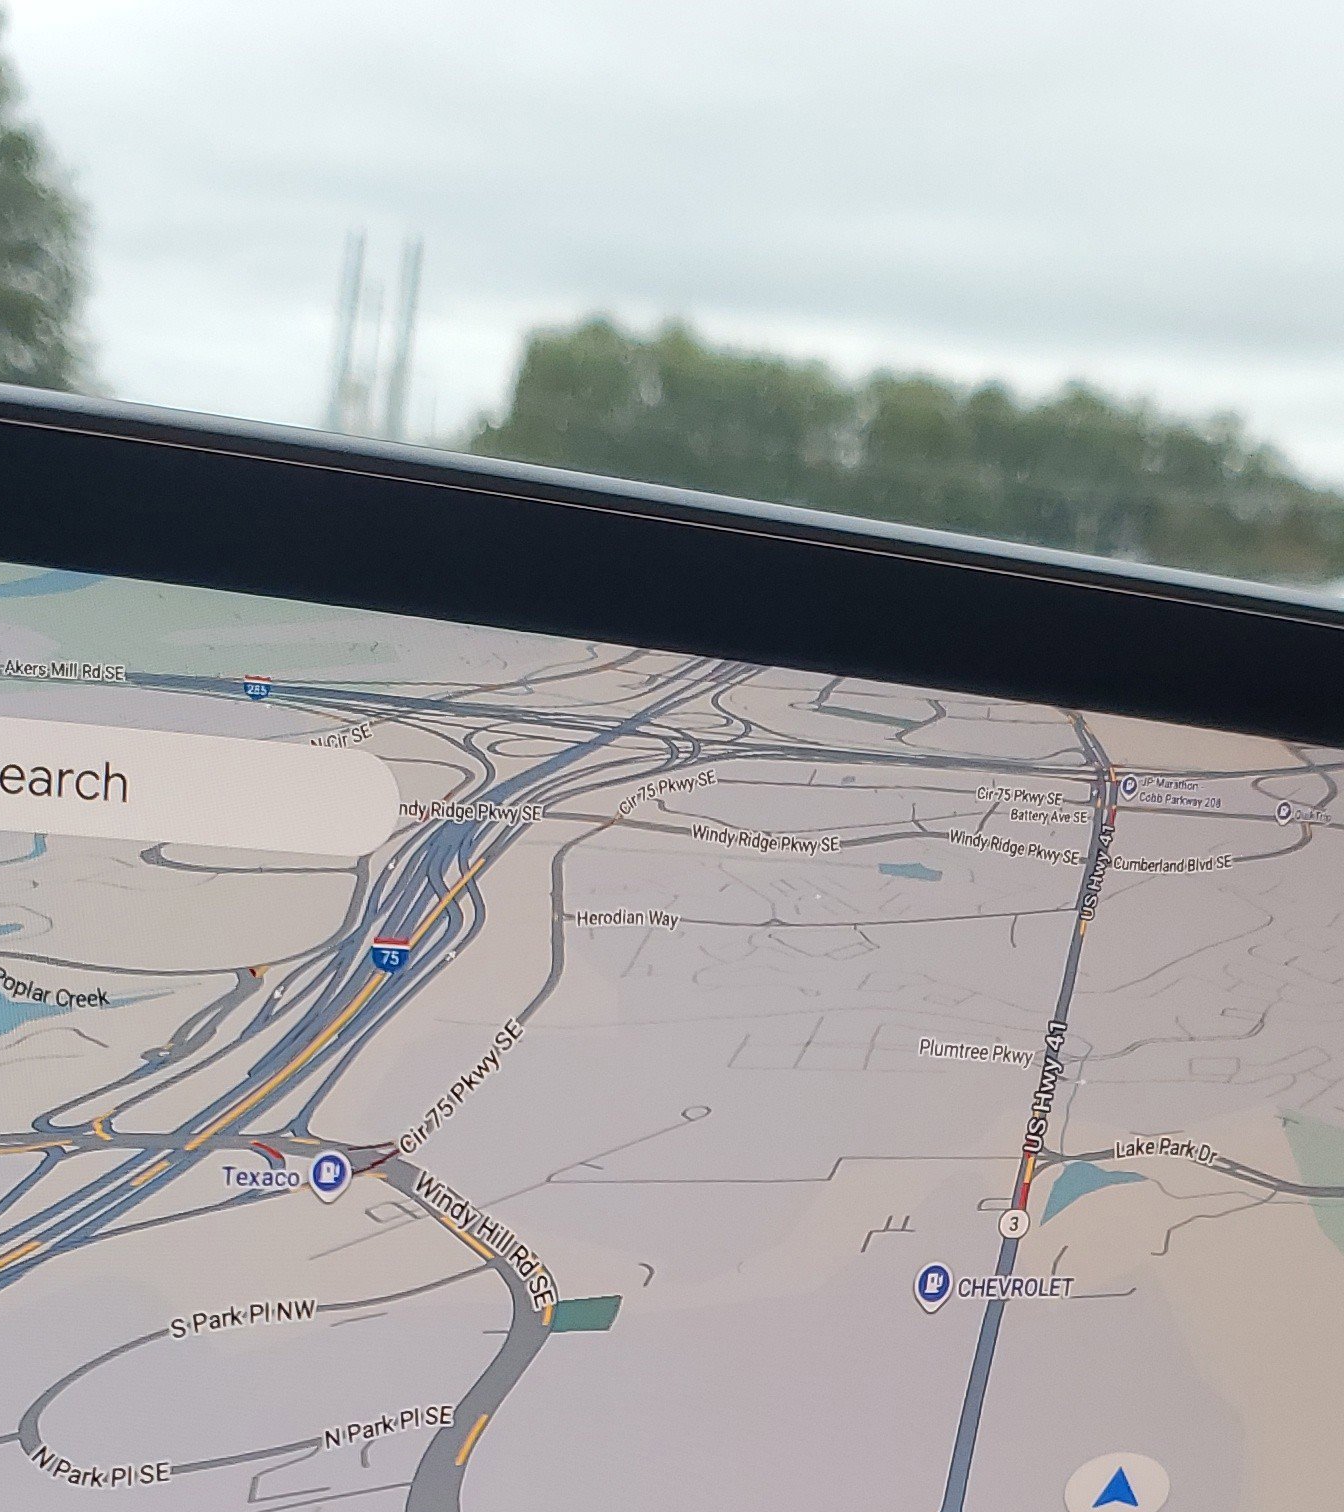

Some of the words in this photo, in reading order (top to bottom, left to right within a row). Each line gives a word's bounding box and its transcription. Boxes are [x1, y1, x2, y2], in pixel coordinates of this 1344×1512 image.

[5, 659, 47, 678] Akers
[51, 661, 77, 678] Mill
[82, 663, 103, 679] Rd
[104, 665, 124, 681] SE
[352, 723, 372, 743] SE
[619, 795, 637, 816] Cir
[658, 774, 697, 795] Pkwy
[697, 770, 716, 787] SE
[1014, 790, 1044, 805] Pkwy
[1047, 792, 1063, 805] SE
[431, 801, 474, 821] Ridge
[478, 803, 519, 824] Pkwy
[521, 805, 542, 822] SE
[1010, 809, 1048, 824] Battery
[1051, 811, 1070, 822] Ave
[1073, 812, 1088, 823] SE
[692, 825, 737, 847] Windy
[739, 831, 778, 852] Ridge
[781, 836, 817, 856] Pkwy
[820, 837, 840, 852] SE
[949, 830, 988, 849] Windy
[990, 837, 1025, 857] Ridge
[1027, 843, 1060, 863] Pkwy
[1062, 851, 1079, 865] SE
[1099, 825, 1115, 847] 41
[1088, 851, 1112, 891] Hwy
[1113, 855, 1184, 873] Cumberland
[1187, 857, 1213, 872] Blvd
[1216, 855, 1232, 868] SE
[1081, 894, 1099, 920] US
[577, 909, 643, 927] Herodian
[648, 911, 680, 931] Way
[381, 950, 400, 965] 75
[55, 986, 111, 1009] Creek
[1047, 1020, 1067, 1053] 41
[919, 1040, 988, 1061] Plumtree
[992, 1043, 1033, 1068] Pkwy
[399, 1124, 430, 1156] Cir
[425, 1095, 455, 1131] 75
[449, 1048, 503, 1104] Pkwy
[494, 1019, 524, 1052] SE
[1033, 1055, 1061, 1113] Hwy
[1023, 1117, 1047, 1153] US
[1115, 1139, 1155, 1159] Lake
[1158, 1139, 1196, 1160] Park
[1197, 1144, 1218, 1164] Dr
[222, 1166, 300, 1187] Texaco
[1009, 1217, 1019, 1232] 3
[414, 1171, 477, 1231] Windy
[477, 1214, 516, 1256] Hill
[513, 1244, 543, 1280] Rd
[528, 1274, 555, 1309] SE
[957, 1277, 1074, 1298] CHEVROLET
[170, 1317, 188, 1339] S
[192, 1307, 245, 1336] Park
[249, 1303, 271, 1323] Pl
[275, 1299, 317, 1321] NW
[323, 1428, 341, 1451] N
[346, 1414, 397, 1444] Park
[400, 1409, 421, 1432] Pl
[424, 1404, 454, 1427] SE
[33, 1445, 55, 1474] N
[52, 1457, 107, 1489] Park
[112, 1464, 134, 1489] Pl
[138, 1460, 172, 1486] SE
